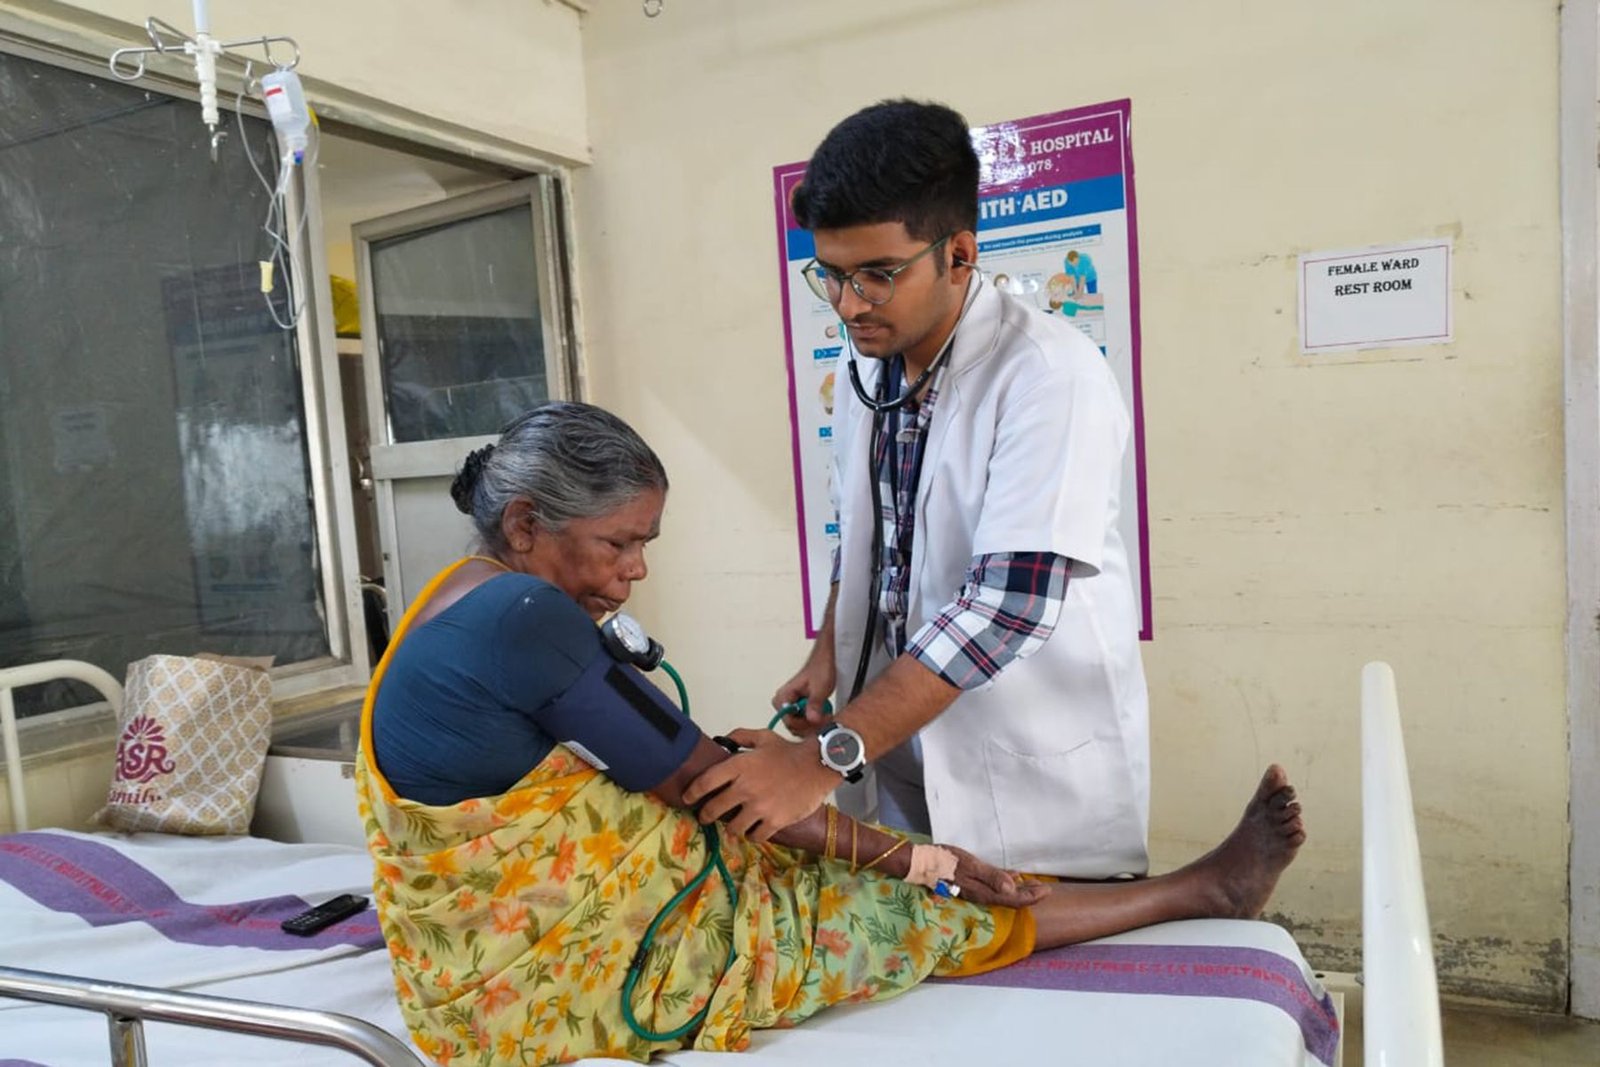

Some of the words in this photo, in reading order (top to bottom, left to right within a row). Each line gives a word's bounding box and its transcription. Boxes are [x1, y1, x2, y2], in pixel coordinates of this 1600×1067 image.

[1030, 128, 1114, 156] HOSPITAL
[980, 197, 1015, 219] ITH
[1021, 189, 1068, 213] AED
[1328, 262, 1379, 276] FEMALE
[1381, 258, 1419, 271] WARD
[1334, 283, 1370, 296] REST
[1373, 279, 1412, 293] ROOM
